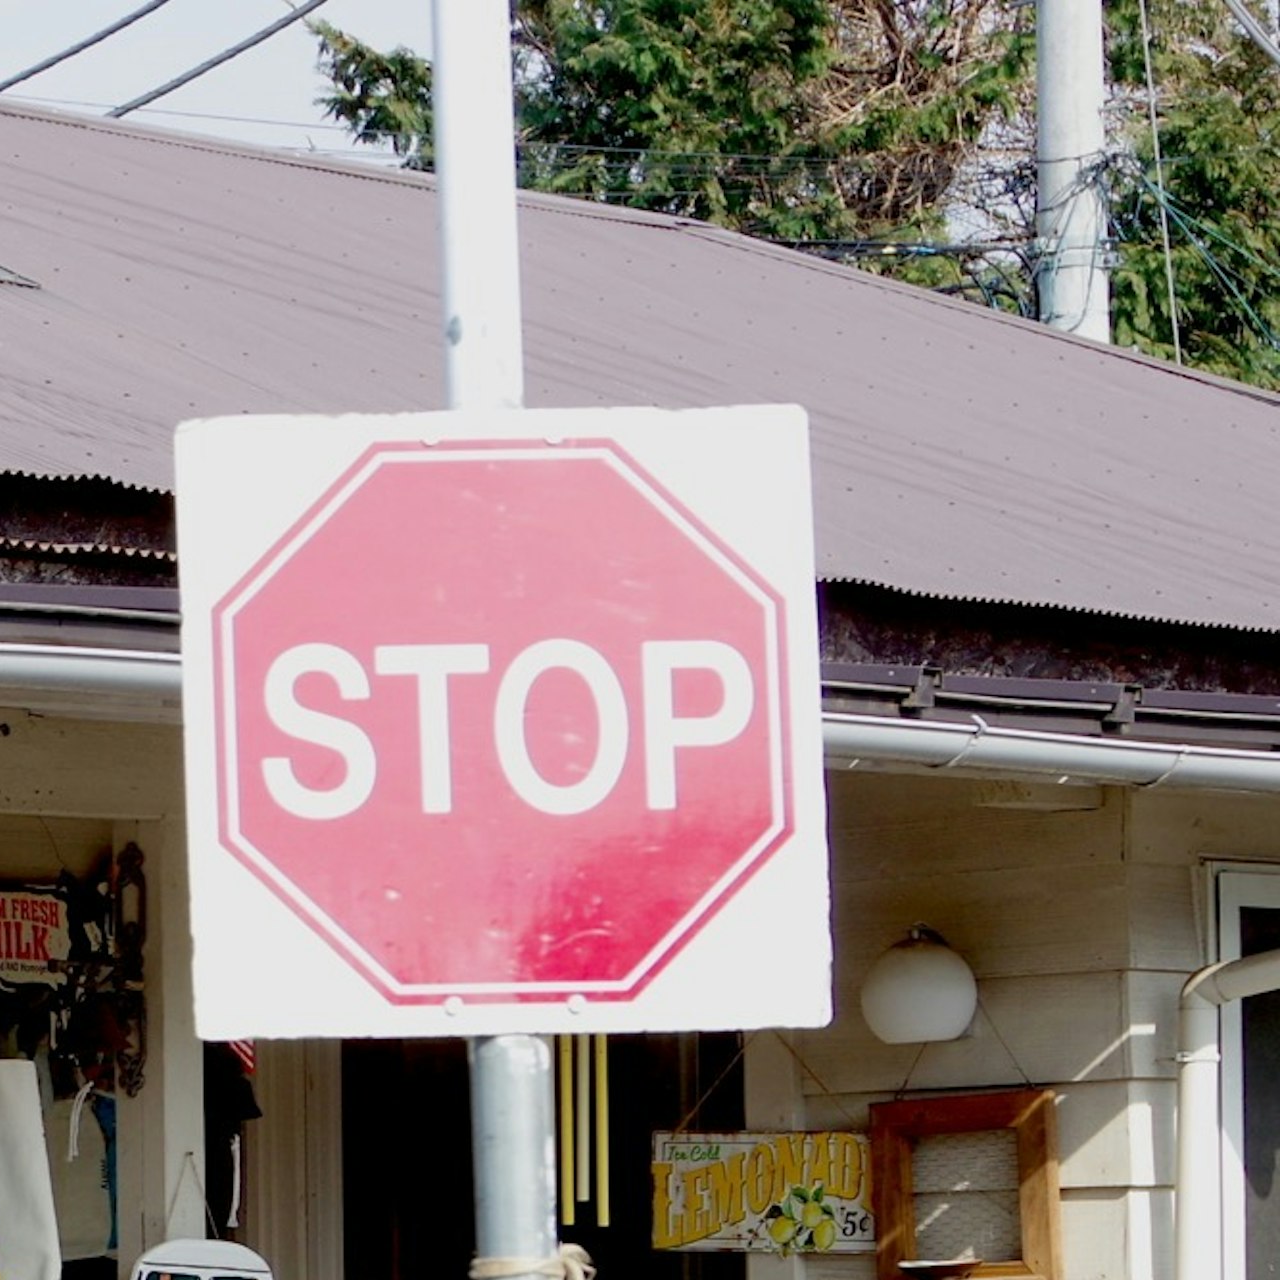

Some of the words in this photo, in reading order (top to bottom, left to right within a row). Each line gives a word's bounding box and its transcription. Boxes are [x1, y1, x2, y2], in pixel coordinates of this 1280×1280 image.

[261, 637, 754, 820] STOP
[12, 898, 59, 929] FRESH
[690, 1143, 720, 1162] Cold
[651, 1131, 870, 1250] LEMONAD
[842, 1206, 871, 1238] 5¢
